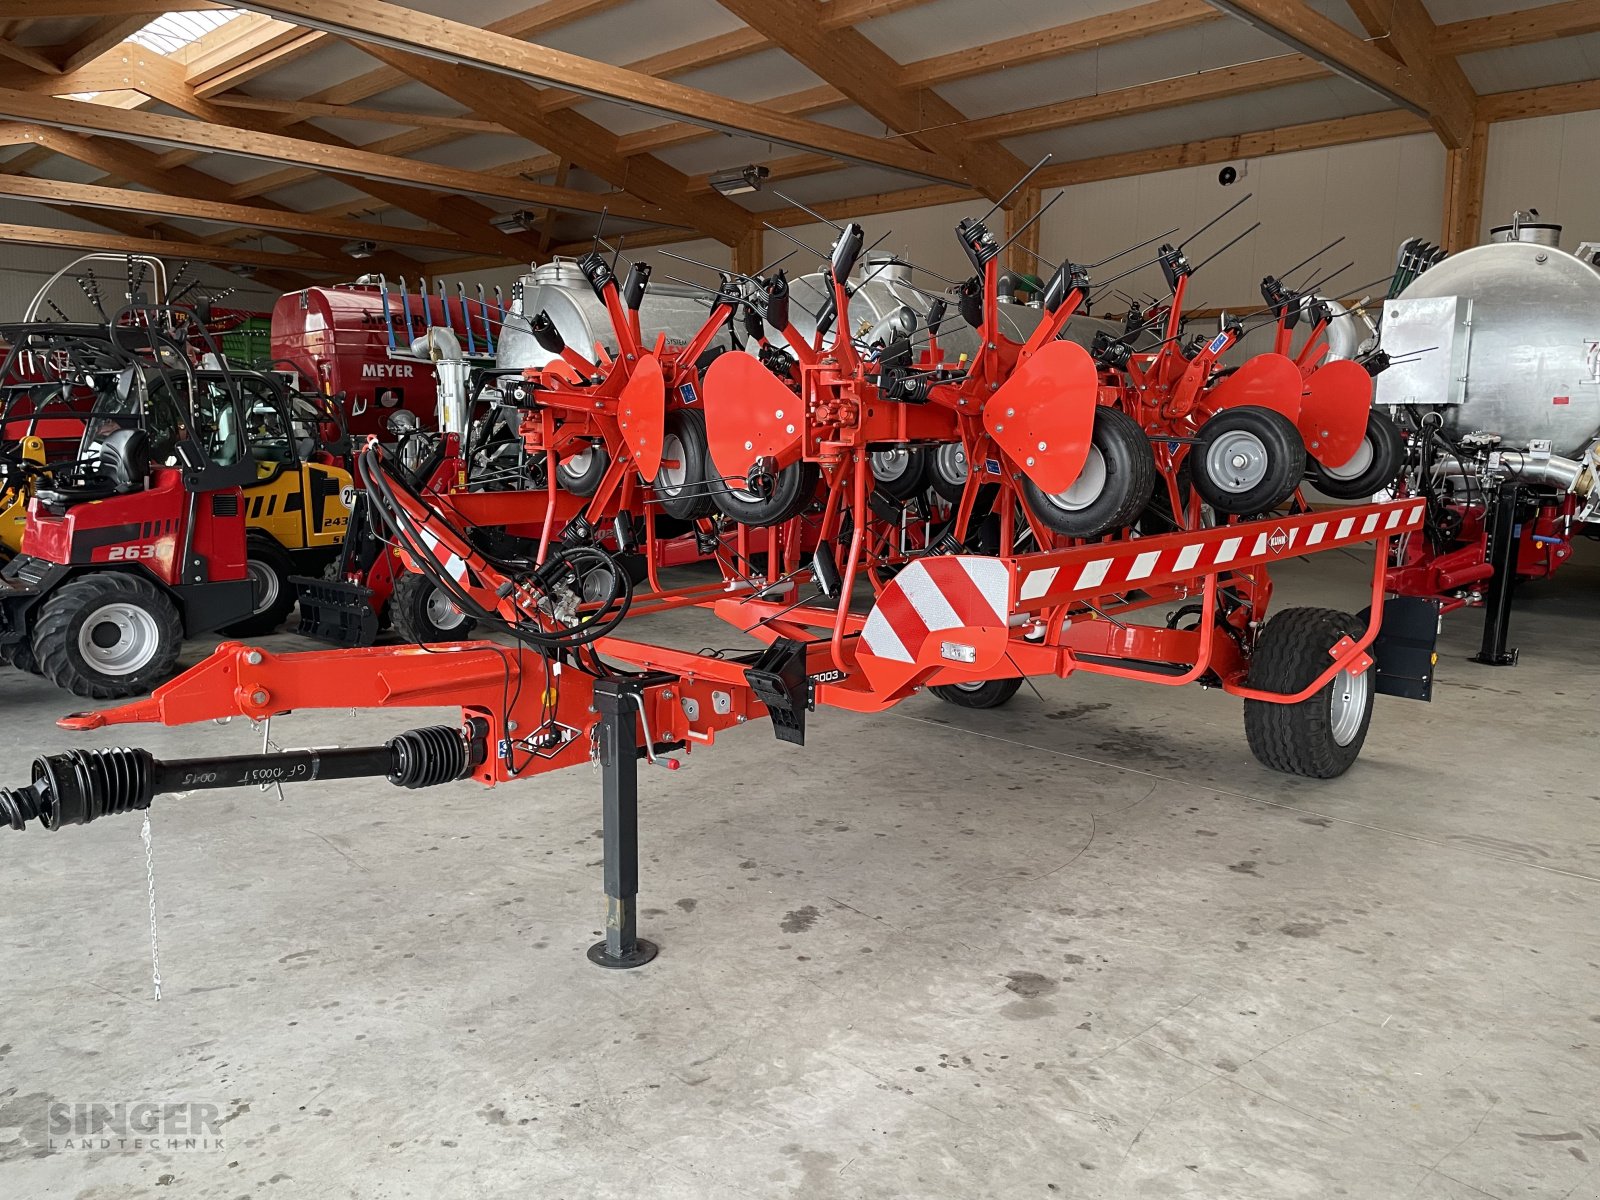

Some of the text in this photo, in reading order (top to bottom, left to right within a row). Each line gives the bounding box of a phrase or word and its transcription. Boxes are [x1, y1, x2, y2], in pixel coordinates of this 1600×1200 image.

[362, 363, 414, 378] MEYER
[527, 728, 572, 750] KUN
[287, 763, 307, 777] GF
